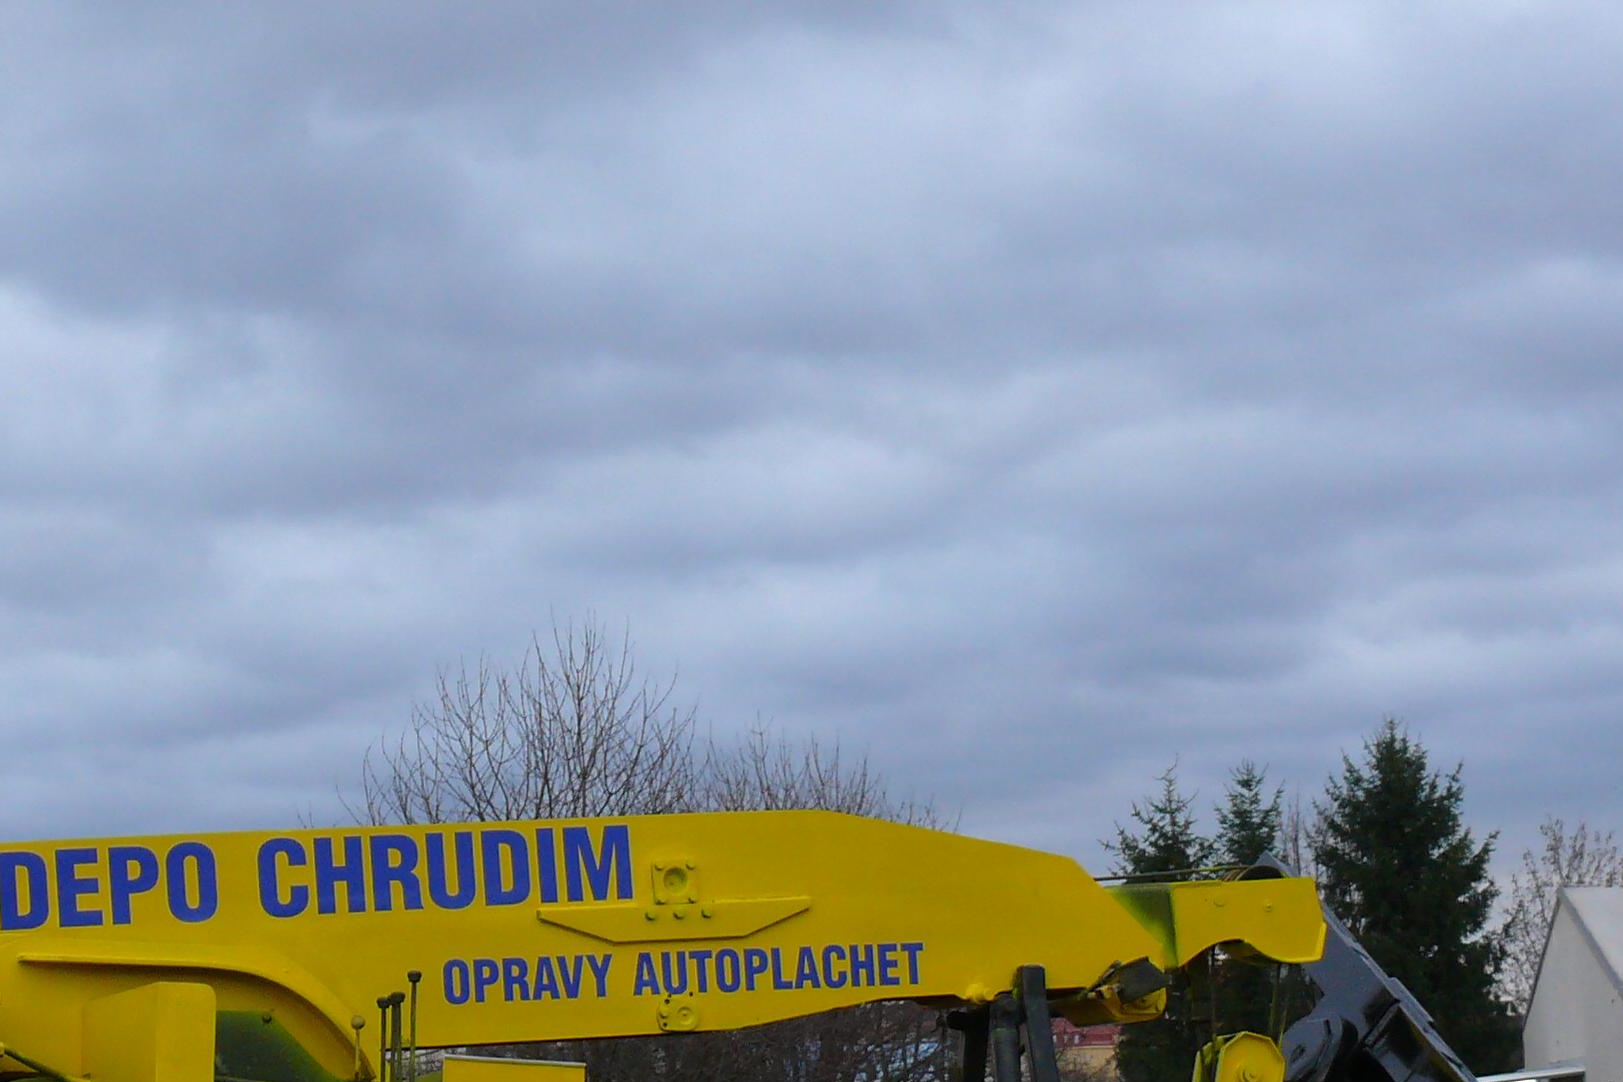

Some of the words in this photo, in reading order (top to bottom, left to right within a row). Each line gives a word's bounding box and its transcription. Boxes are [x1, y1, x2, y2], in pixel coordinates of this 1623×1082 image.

[257, 825, 634, 918] CHRUDIM
[443, 953, 613, 1005] OPRAVY
[633, 942, 924, 996] AUTOPLACHET
